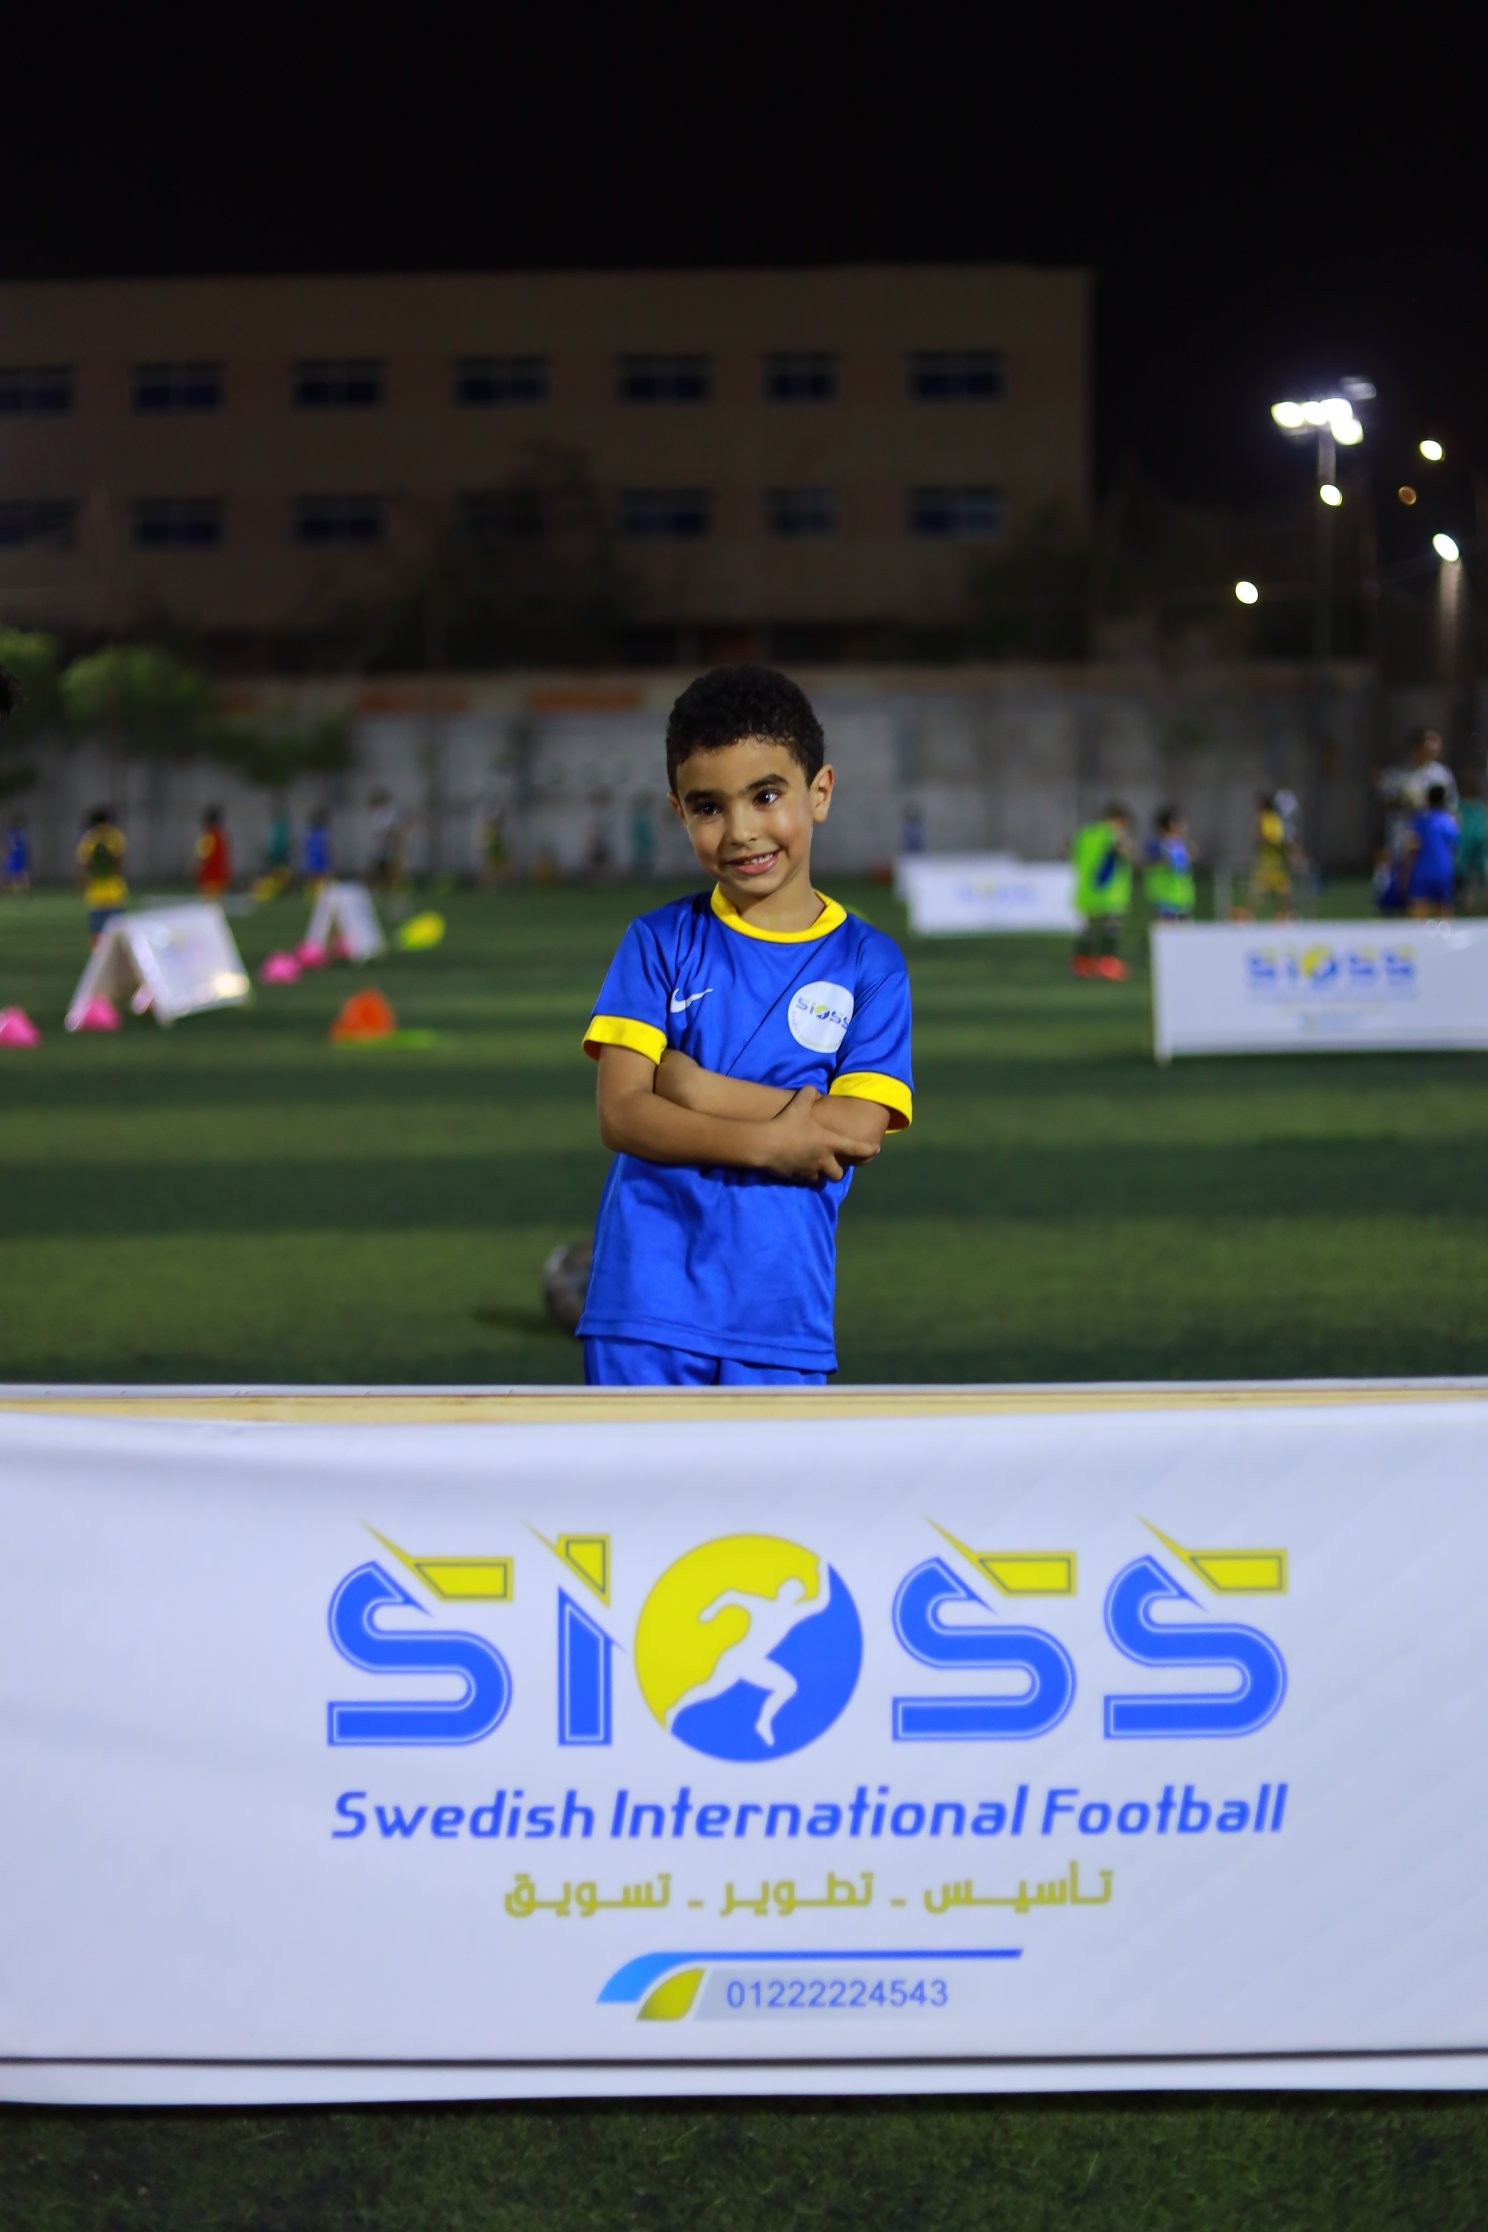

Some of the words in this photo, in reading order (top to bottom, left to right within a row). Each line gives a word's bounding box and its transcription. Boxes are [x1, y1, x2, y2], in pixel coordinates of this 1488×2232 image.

[331, 1787, 597, 1840] Swedish
[609, 1783, 1030, 1839] International
[1040, 1781, 1290, 1836] Football
[504, 1872, 673, 1919] تسويق
[720, 1871, 875, 1918] تطوير
[725, 1977, 950, 2011] 01222224543
